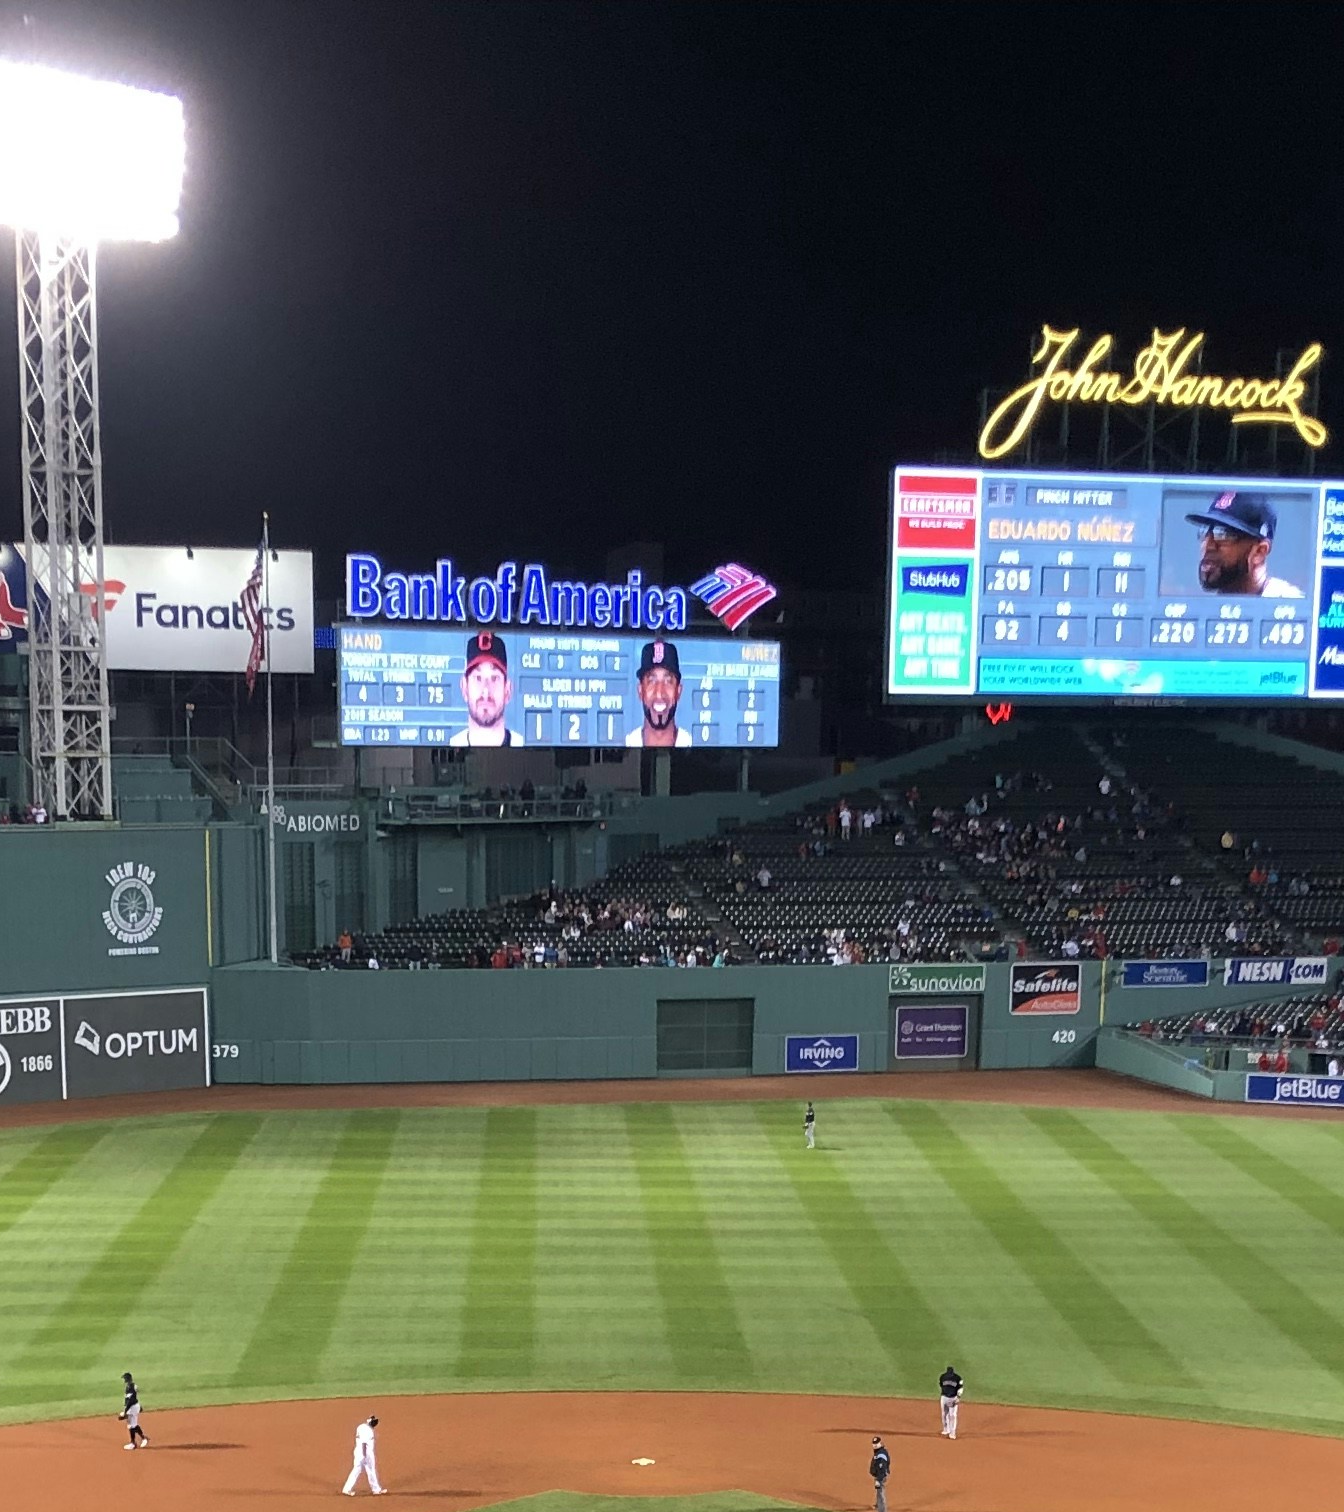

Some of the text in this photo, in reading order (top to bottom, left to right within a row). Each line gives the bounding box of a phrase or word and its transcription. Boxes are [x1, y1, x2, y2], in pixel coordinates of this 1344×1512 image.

[979, 324, 1326, 458] John Hancock
[989, 520, 1071, 541] EDUARDO
[909, 570, 960, 588] StubHub
[346, 554, 687, 630] Bank of America
[136, 592, 295, 632] Fanatcs
[995, 620, 1019, 642] 92
[1153, 622, 1195, 644] .220
[1208, 623, 1249, 644] .273
[343, 633, 383, 651] HAND
[1259, 672, 1298, 685] jetBlue
[427, 686, 444, 703] 75
[569, 714, 581, 740] 2
[287, 815, 360, 832] ABIOMED
[138, 863, 155, 885] 103
[1238, 961, 1284, 981] NESN
[910, 975, 983, 991] sunovion
[1013, 979, 1077, 993] Safelite
[105, 1028, 198, 1058] OPTUM
[1052, 1030, 1075, 1044] 420
[212, 1044, 239, 1058] 379
[800, 1046, 844, 1060] IRVING
[20, 1055, 53, 1073] 1866
[1273, 1078, 1342, 1101] jetBlue
